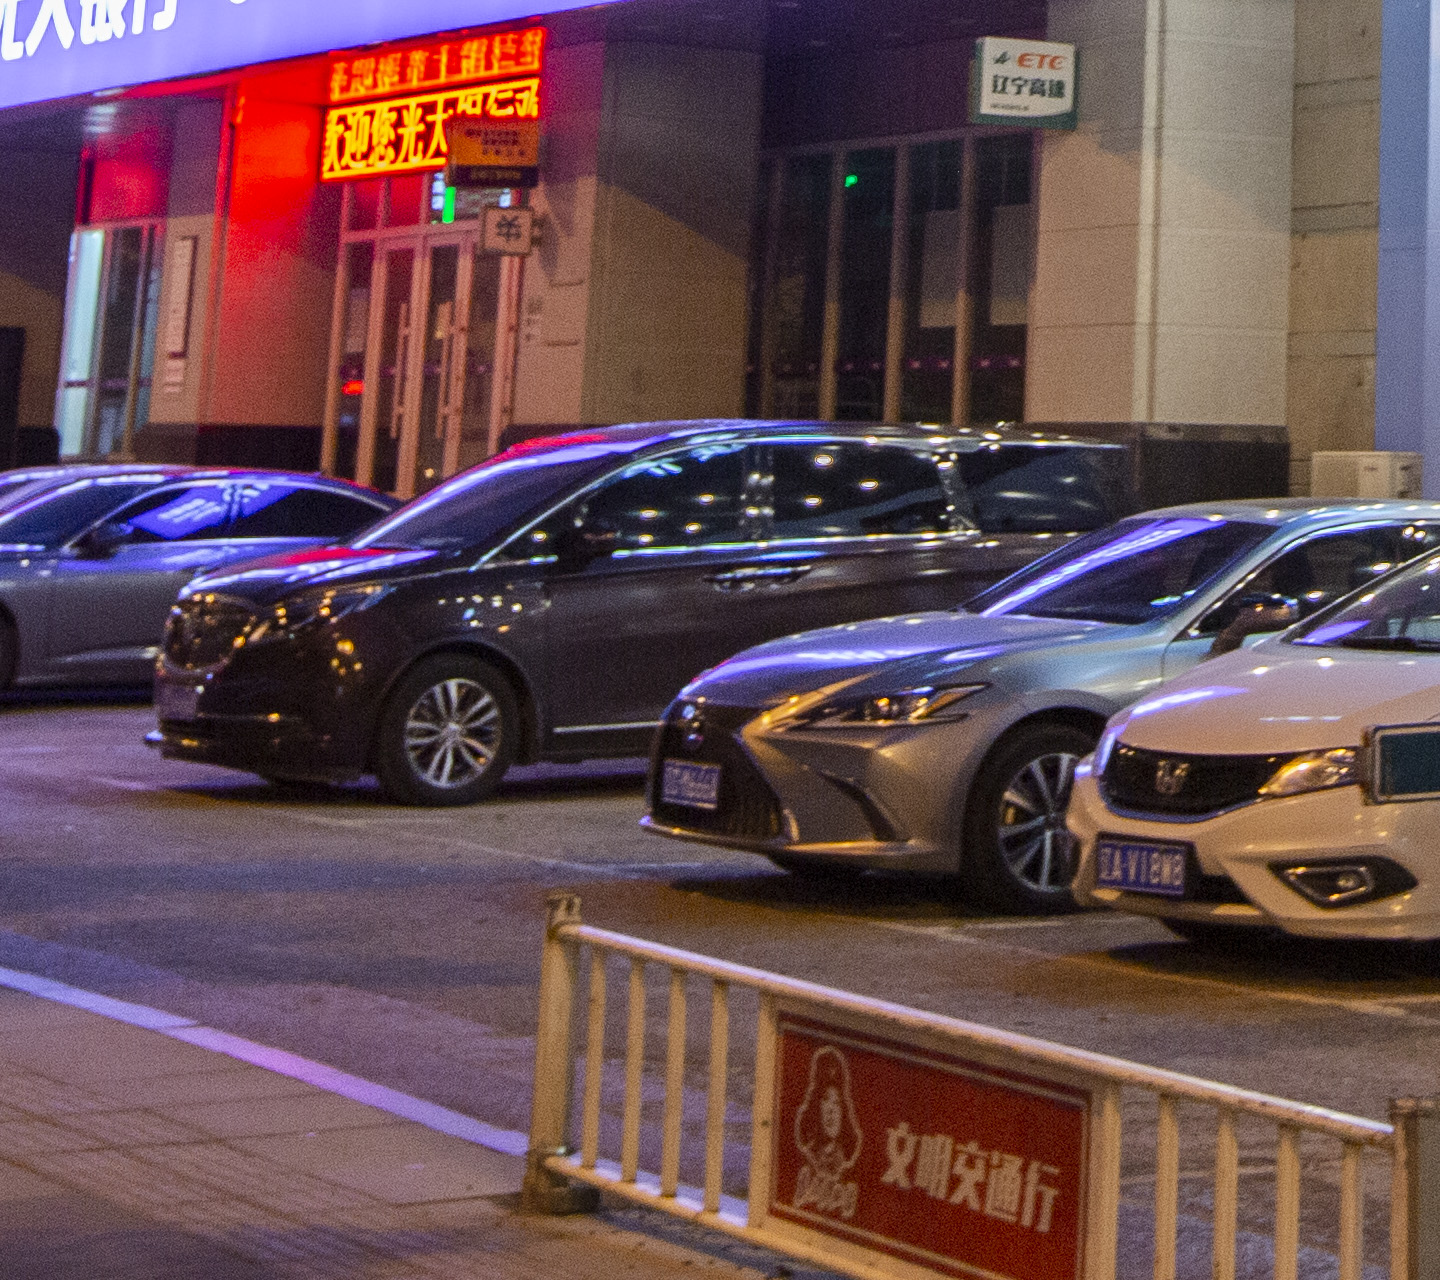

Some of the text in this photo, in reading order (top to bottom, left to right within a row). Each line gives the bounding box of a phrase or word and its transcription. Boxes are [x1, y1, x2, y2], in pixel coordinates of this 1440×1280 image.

[1016, 52, 1066, 71] ETC
[880, 1121, 1060, 1234] 文明交通行
